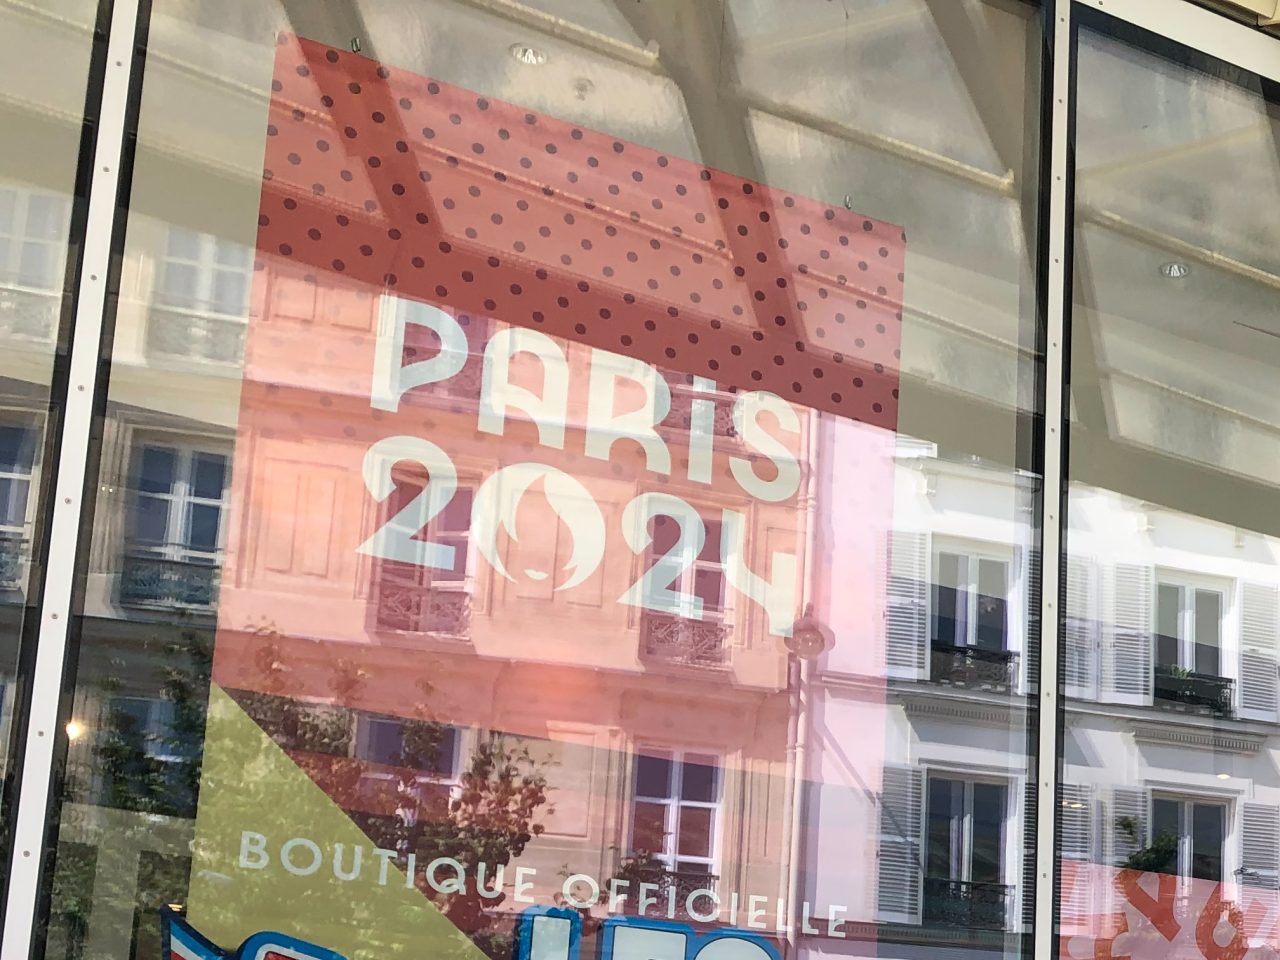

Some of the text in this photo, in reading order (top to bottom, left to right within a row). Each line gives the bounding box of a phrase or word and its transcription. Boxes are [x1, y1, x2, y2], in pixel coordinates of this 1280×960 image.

[369, 294, 801, 501] PARIS
[354, 435, 796, 638] 2024
[238, 830, 849, 939] BOUTIQUE OFFICIELLE
